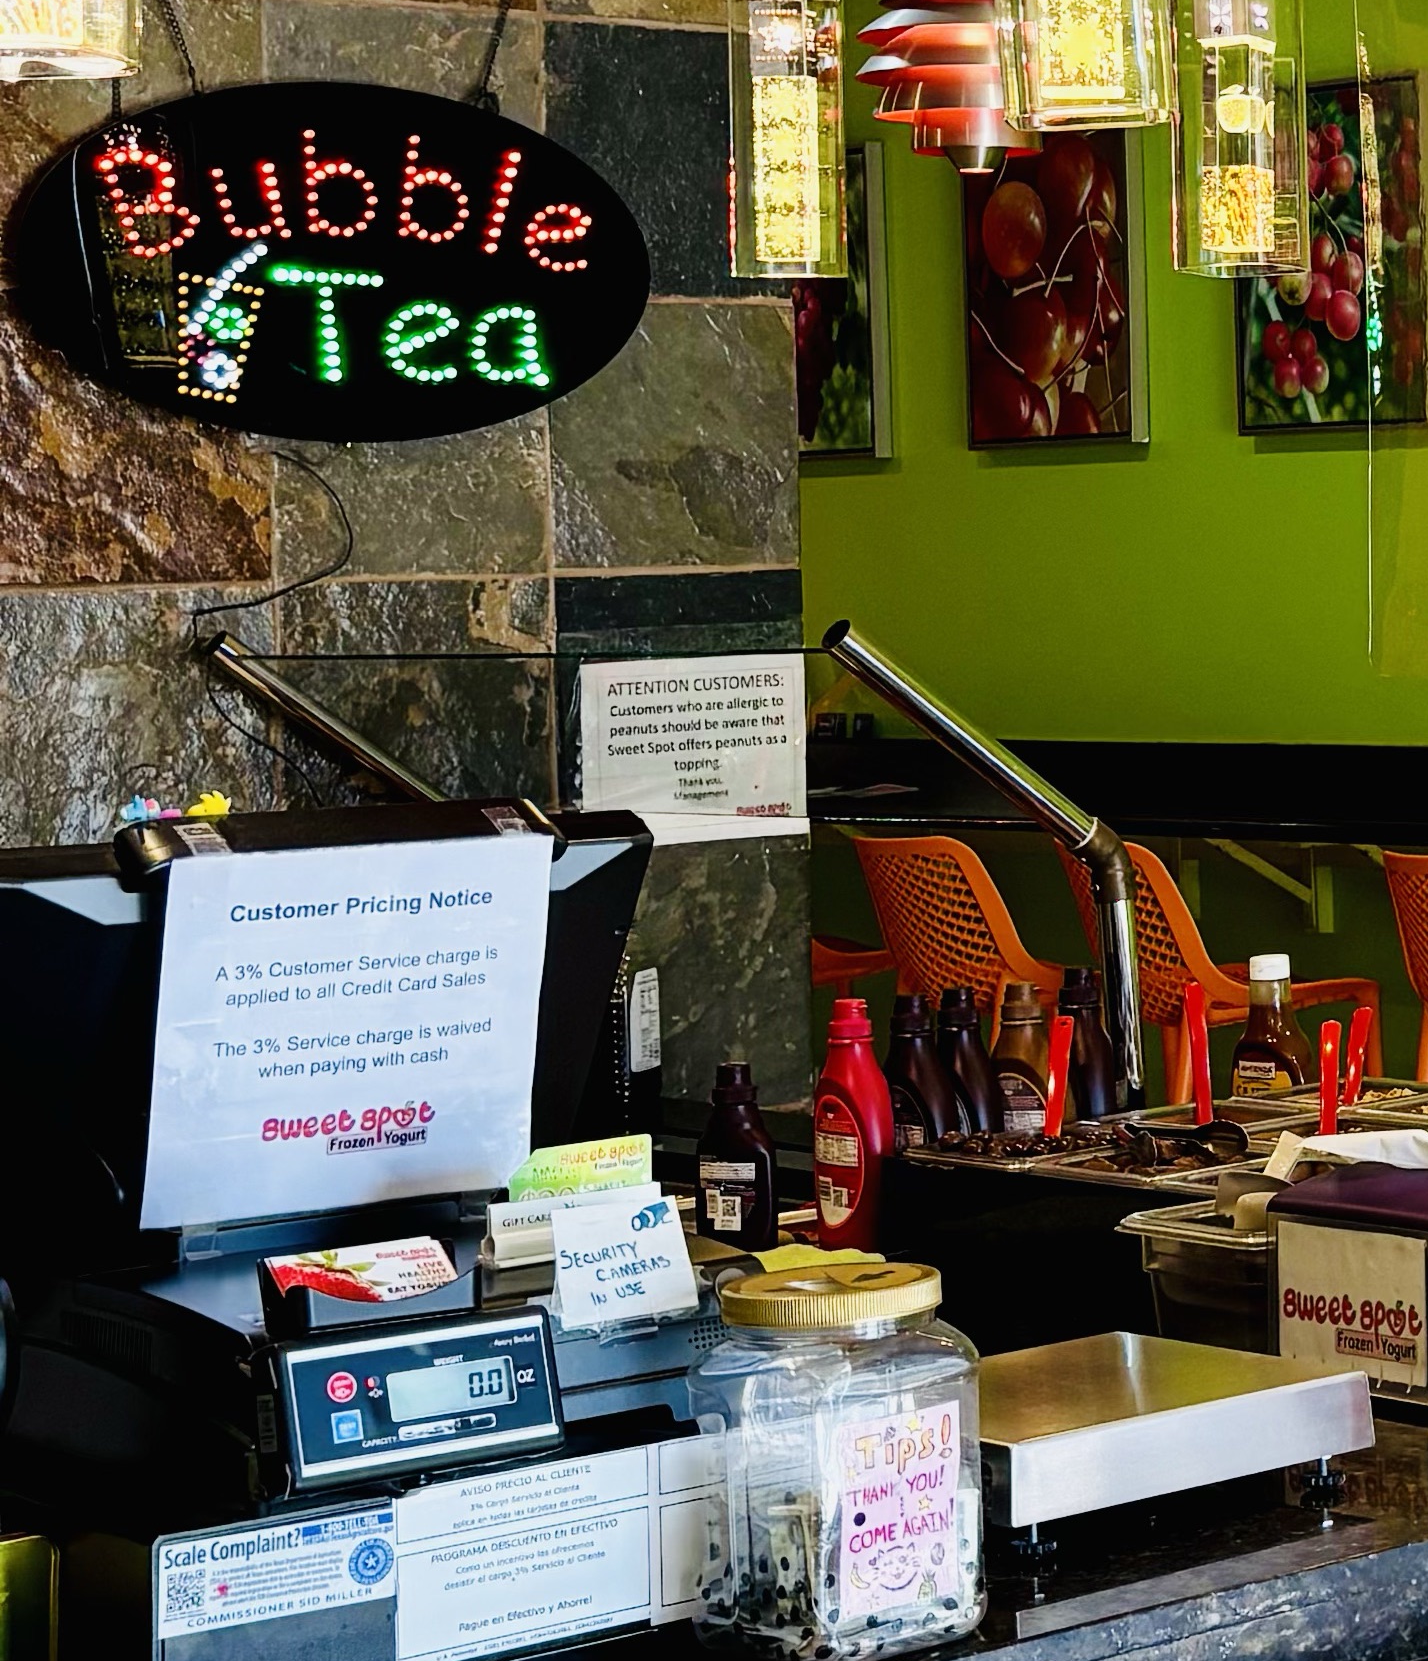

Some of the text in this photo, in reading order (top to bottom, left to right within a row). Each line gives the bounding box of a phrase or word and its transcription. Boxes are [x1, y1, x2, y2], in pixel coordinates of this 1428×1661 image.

[95, 127, 593, 271] Bubble
[268, 264, 550, 387] Tea
[607, 674, 785, 697] ATTENTION CUSTOMERS:
[610, 696, 784, 718] Customers who are allergic to
[609, 714, 785, 739] peanuts should be aware that
[607, 735, 788, 757] Sweet Spot offers peanuts as a
[230, 889, 493, 922] Customer Pricing Notice
[215, 945, 499, 982] A 3% Customer Service charge is
[225, 972, 486, 1008] applied to all Credit Card Sales
[213, 1018, 493, 1058] The 3% Service charge is waived
[258, 1047, 449, 1079] when paying with cash
[261, 1100, 436, 1143] sweet spot
[329, 1129, 427, 1152] Frozen Yogurt
[502, 1216, 525, 1228] GIFT
[560, 1240, 638, 1269] SECURITY
[596, 1255, 671, 1282] CAMERAS
[590, 1281, 646, 1307] IN USE
[1282, 1287, 1423, 1349] sweet spot
[1336, 1330, 1417, 1362] Frozen Yogurt
[468, 1368, 503, 1398] 0.0
[516, 1368, 536, 1384] OZ
[855, 1413, 952, 1475] Tips!
[460, 1482, 492, 1497] AVISO
[906, 1464, 945, 1494] YOU!
[850, 1497, 954, 1554] COME AGAIN!
[164, 1546, 206, 1570] Scale
[210, 1528, 301, 1562] Complaint?
[187, 1587, 373, 1628] COMMISSIONER SID MILLER
[491, 1616, 505, 1625] en
[548, 1603, 555, 1613] y
